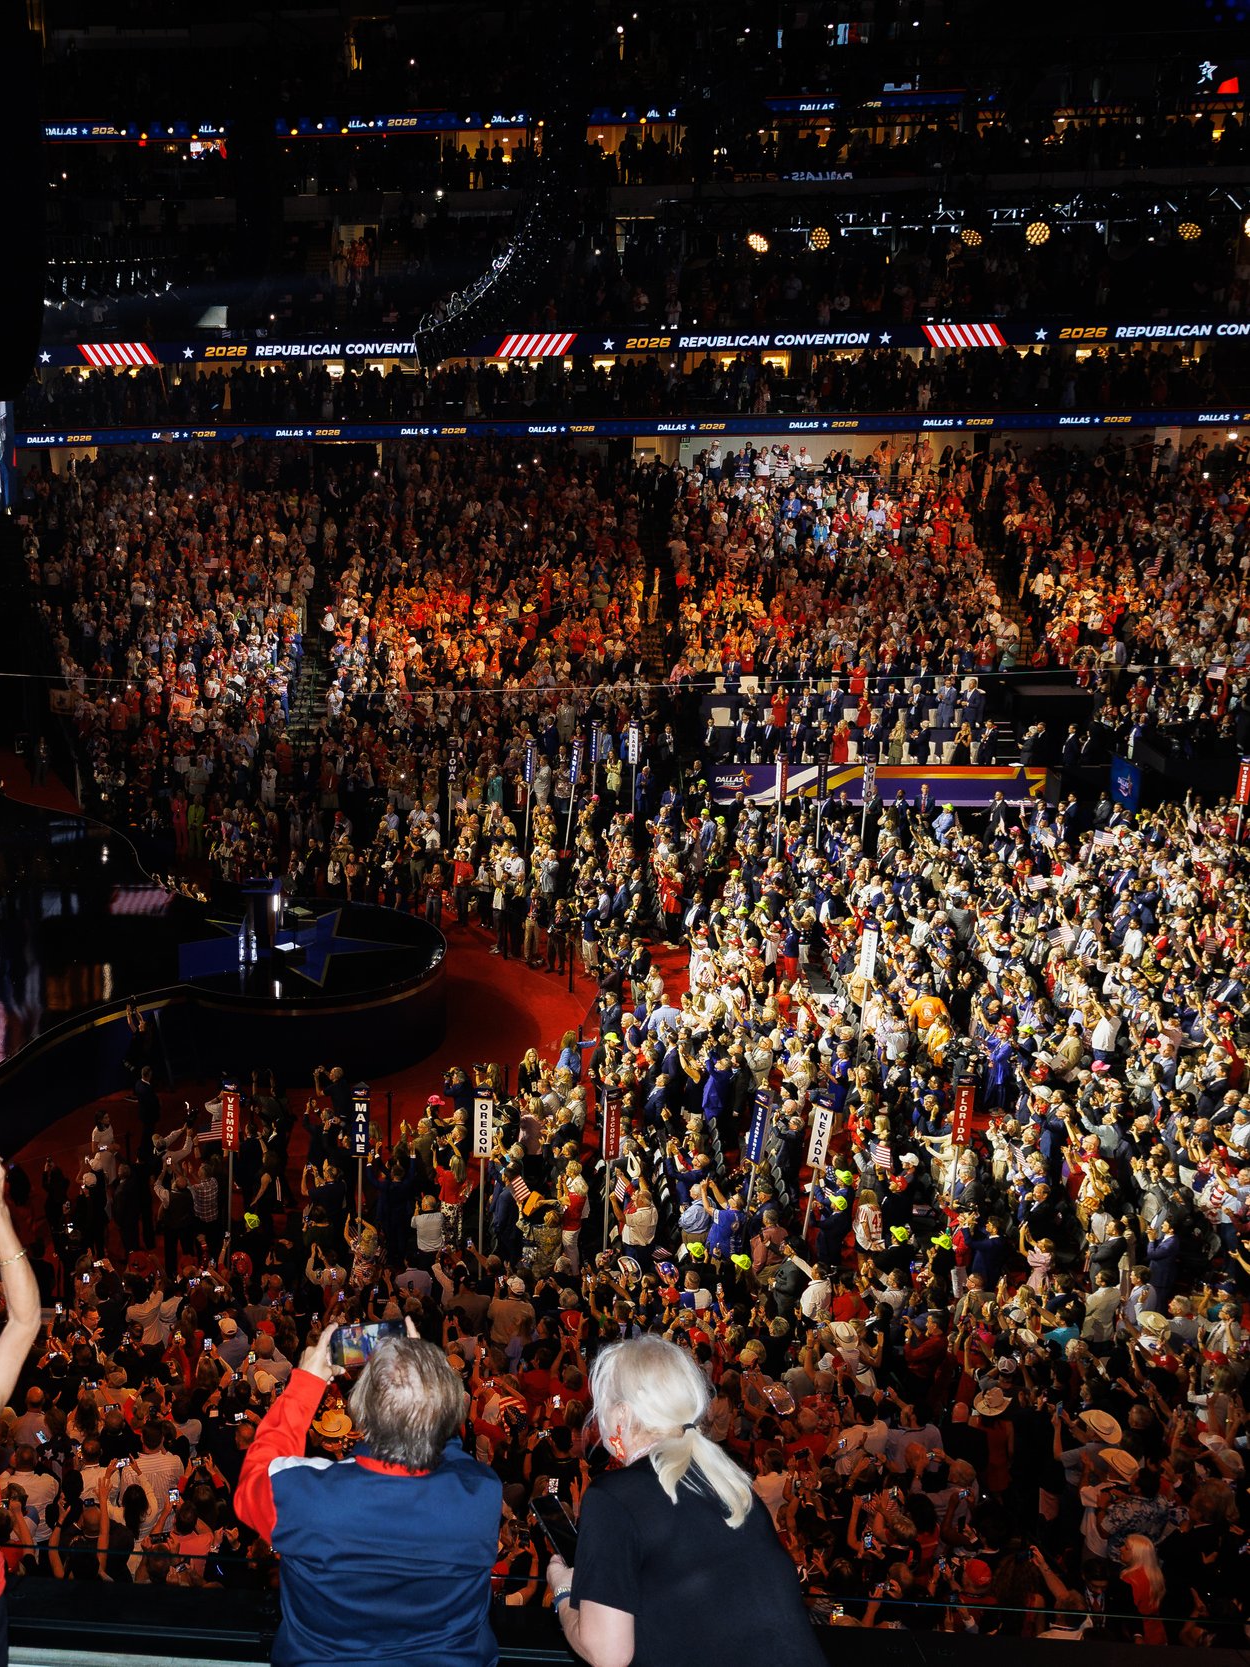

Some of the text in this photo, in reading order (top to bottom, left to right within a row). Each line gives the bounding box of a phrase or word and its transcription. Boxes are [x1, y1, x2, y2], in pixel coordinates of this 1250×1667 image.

[387, 118, 418, 127] 2026
[1059, 327, 1108, 339] 2026
[1115, 324, 1213, 338] REPUBLICAN
[625, 332, 870, 349] 2026 REPUBLICAN CONVENTION
[204, 342, 418, 357] 2026 REPUBLICAN CONVENTI
[788, 420, 859, 429] DALLAS 2026
[922, 418, 994, 427] DALLAS 2026
[1059, 416, 1091, 424] DALLAS
[1198, 413, 1230, 422] DALLAS
[275, 429, 304, 437] DALLAS
[400, 427, 467, 435] DALLAS 2026
[528, 425, 557, 433] DALLAS
[657, 423, 687, 431] DALLAS
[26, 436, 55, 444] DALLAS
[448, 750, 457, 780] IOWA
[570, 749, 579, 782] HAWAII
[867, 766, 875, 798] OHIO
[1239, 766, 1250, 802] MINNESOTA
[226, 1096, 234, 1147] VERMONT
[955, 1090, 969, 1142] FLORIDA
[355, 1103, 367, 1153] MAINE
[479, 1103, 488, 1153] OREGON
[609, 1104, 617, 1156] WISCONSIN
[812, 1112, 828, 1165] NEVADA
